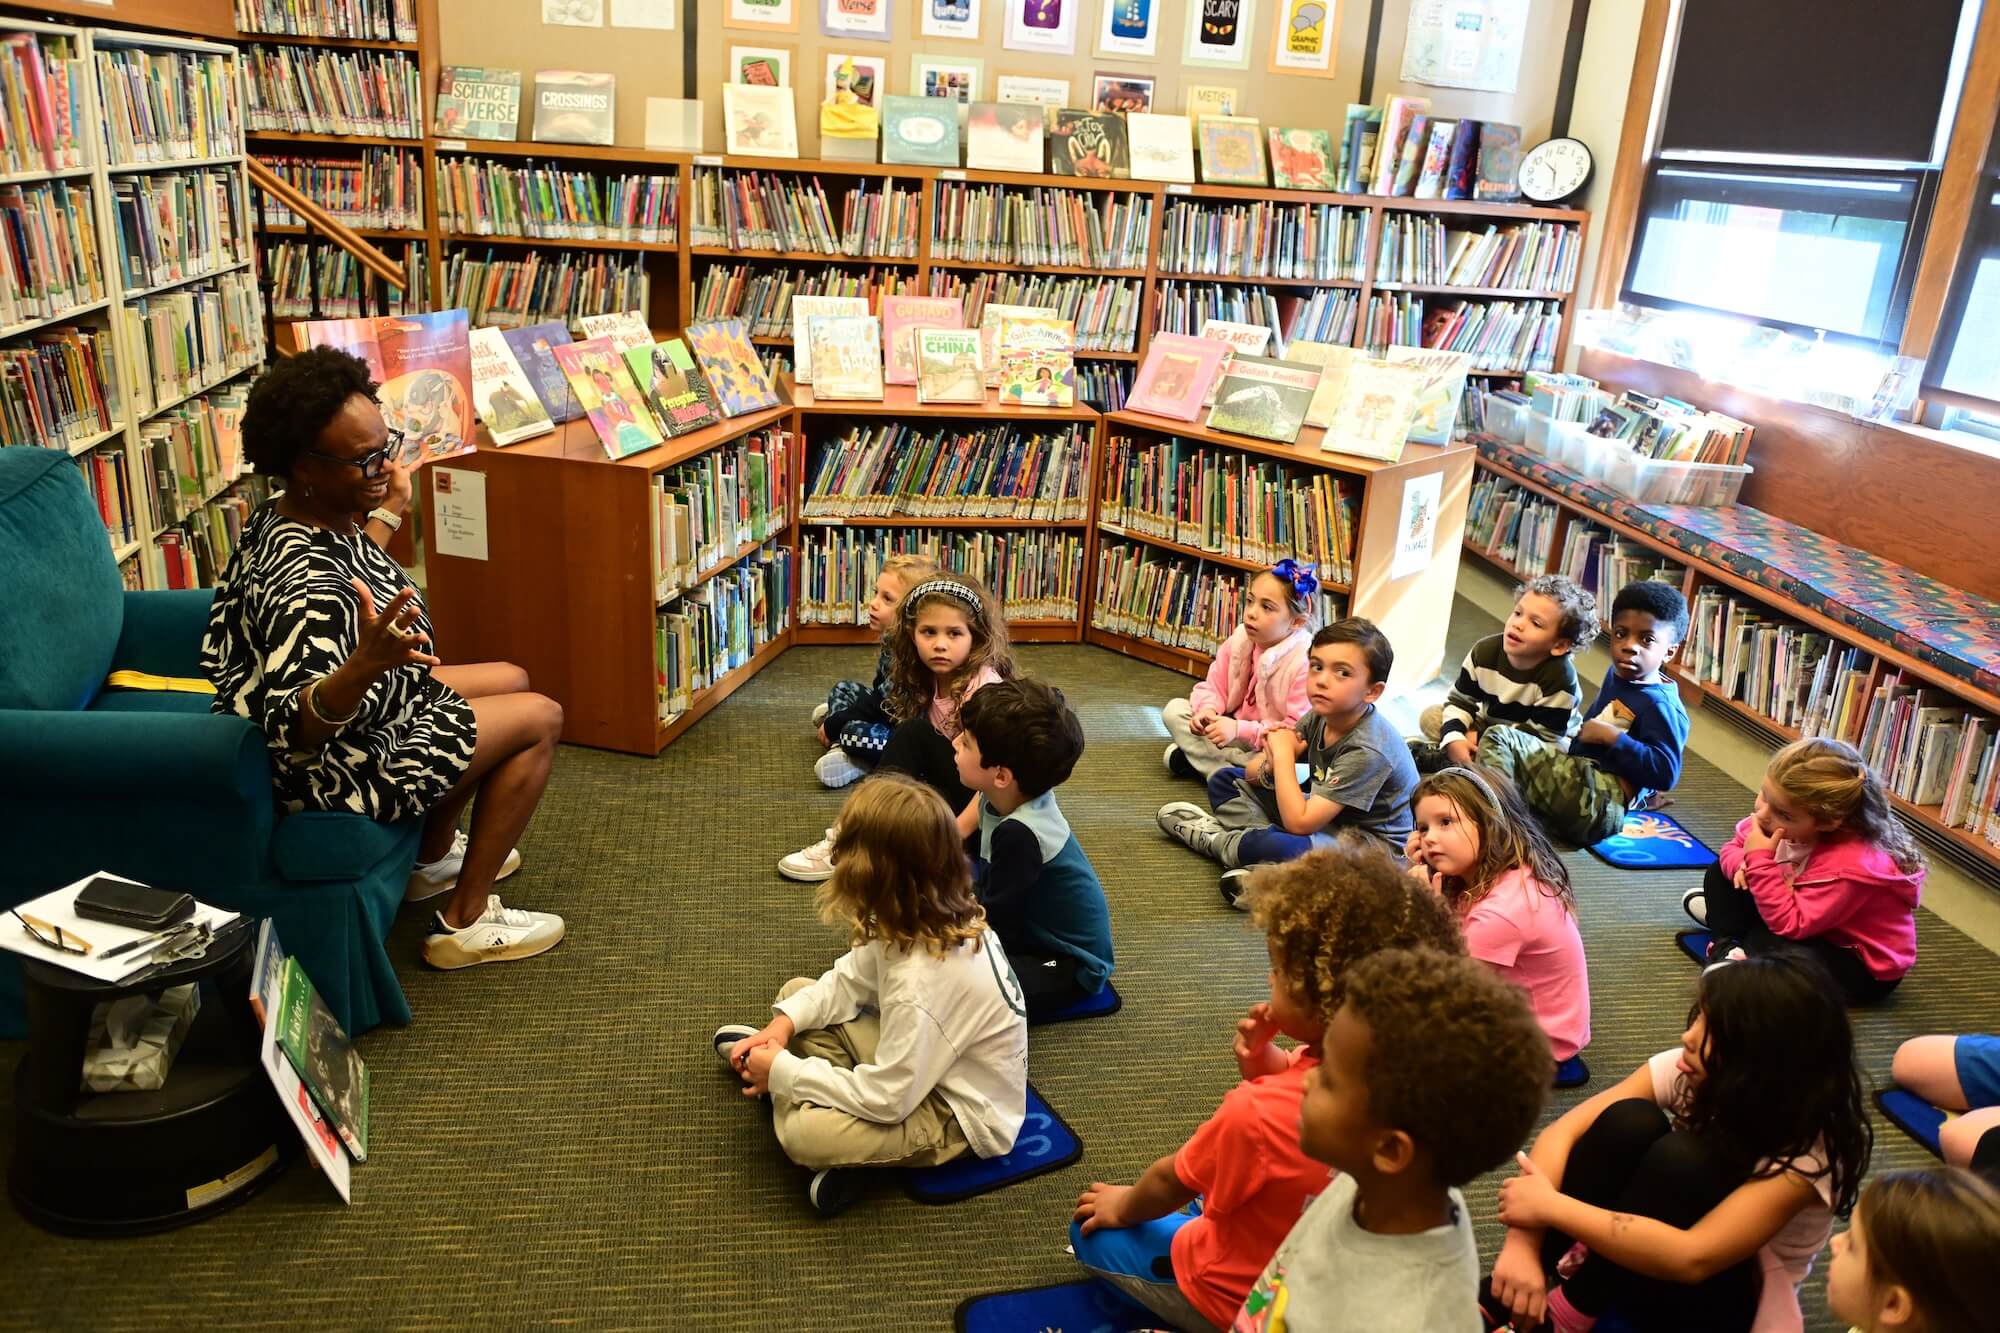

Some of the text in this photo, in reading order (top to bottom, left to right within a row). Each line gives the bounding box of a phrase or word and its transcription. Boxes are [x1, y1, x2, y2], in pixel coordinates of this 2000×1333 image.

[1204, 0, 1239, 18] SCARY
[453, 83, 508, 100] SCIENCE
[541, 91, 607, 109] CROSSINGS
[466, 101, 517, 122] VERSE
[1556, 145, 1567, 155] 12
[1205, 328, 1263, 345] BIG MESS
[925, 342, 977, 354] CHINA
[659, 391, 699, 410] Peregrine
